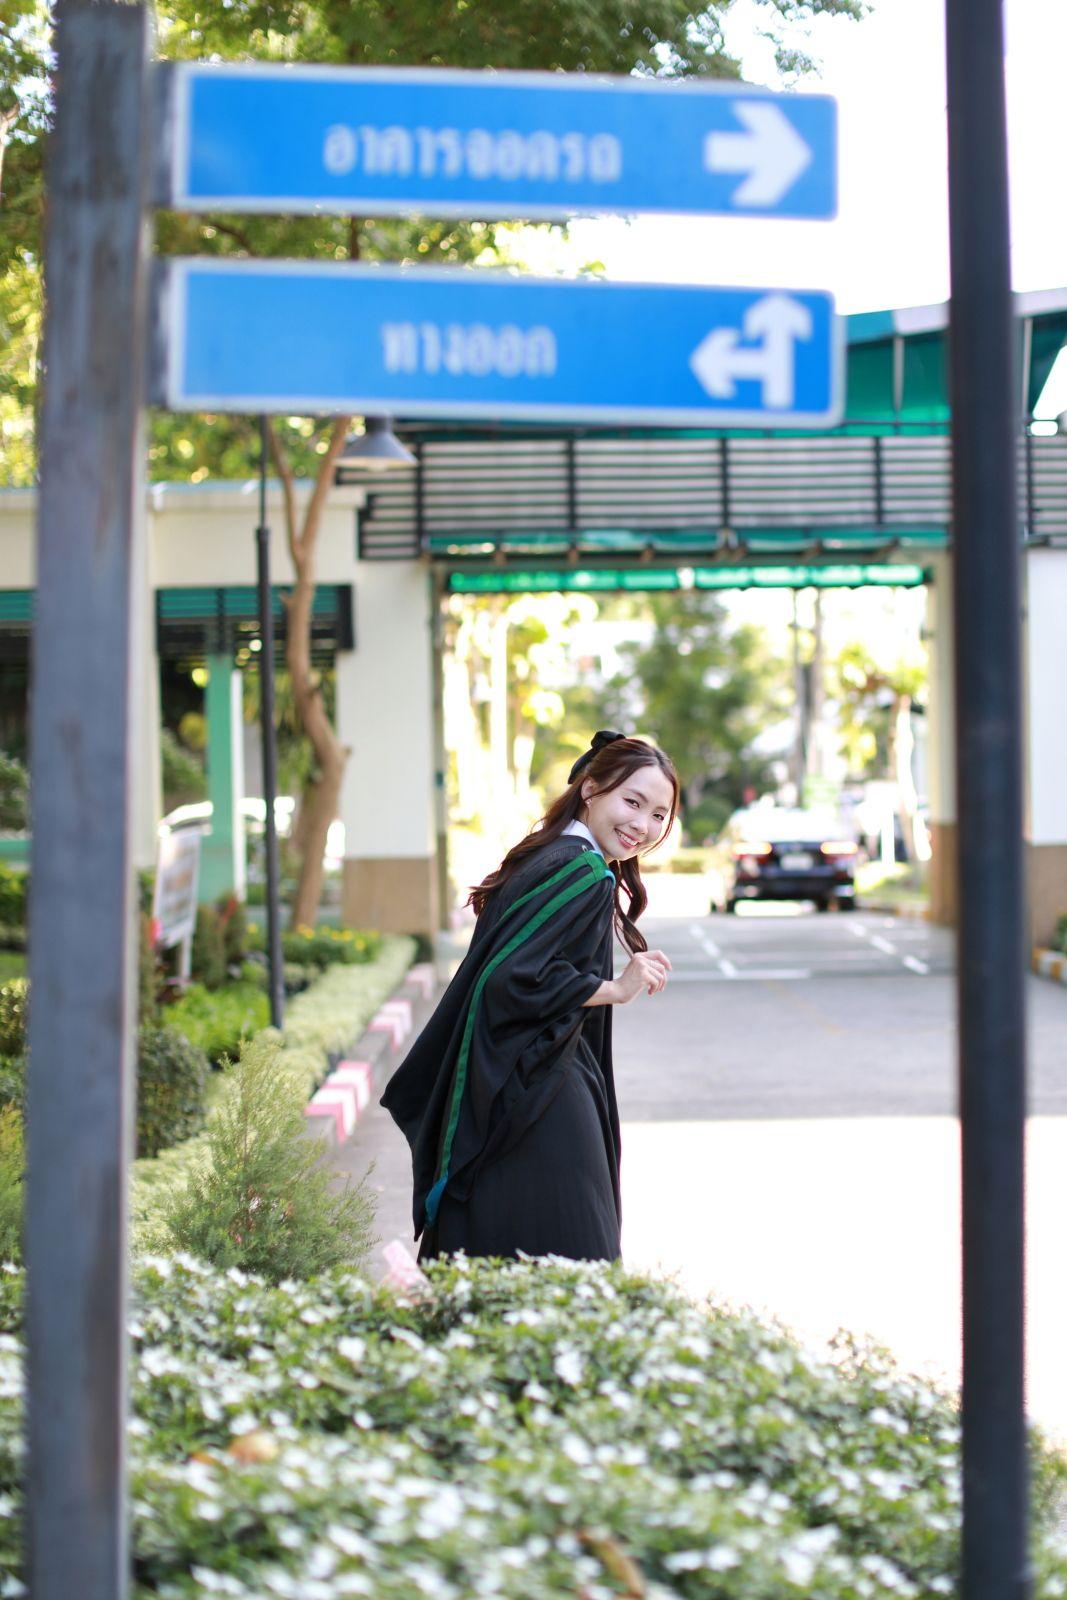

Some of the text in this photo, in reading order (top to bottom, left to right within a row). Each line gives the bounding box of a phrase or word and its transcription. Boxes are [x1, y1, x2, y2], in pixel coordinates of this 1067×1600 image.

[323, 124, 622, 182] อาคารจอดรถ
[380, 322, 557, 378] ทางออก
